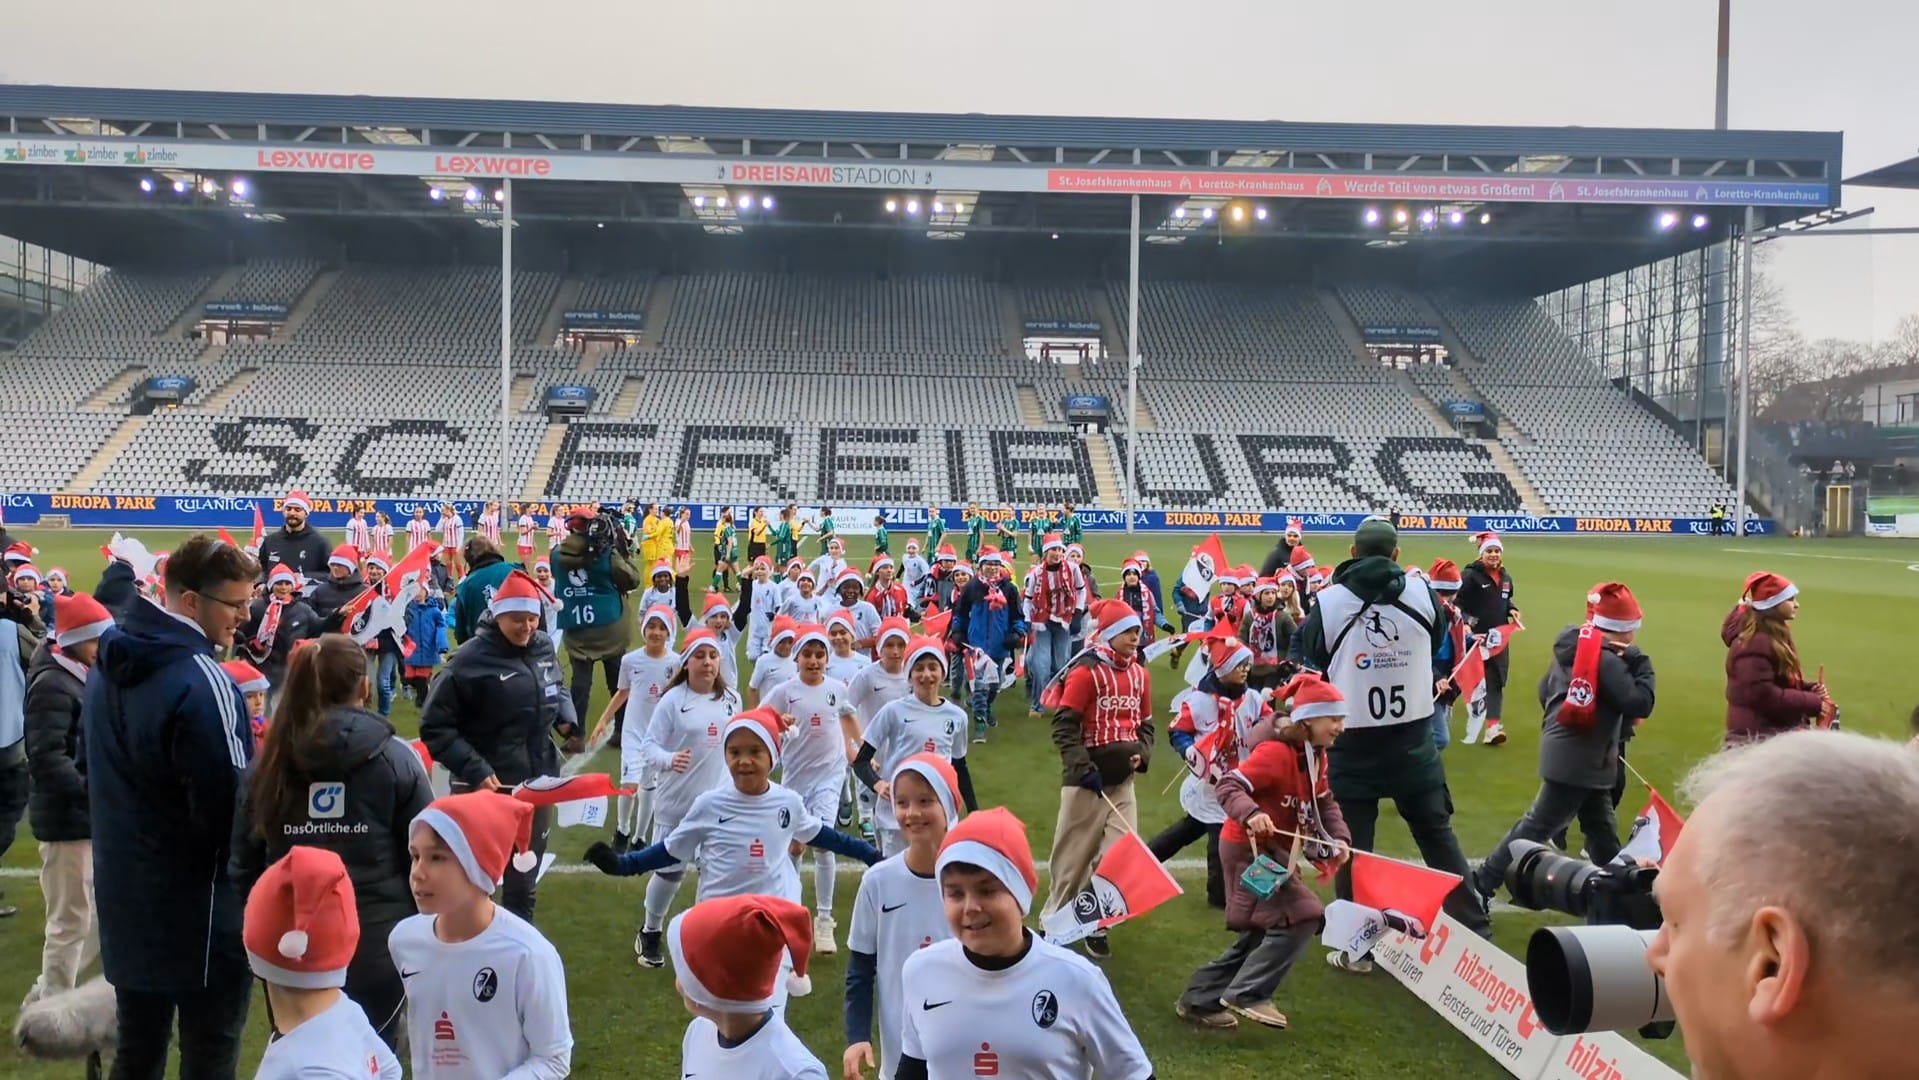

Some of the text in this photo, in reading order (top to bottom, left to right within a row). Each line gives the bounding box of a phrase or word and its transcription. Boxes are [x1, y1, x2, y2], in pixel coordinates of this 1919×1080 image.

[28, 145, 58, 161] zimber
[87, 146, 118, 162] zimber
[147, 148, 178, 163] zimber
[257, 150, 375, 170] Lexware
[434, 156, 551, 175] Lexware
[1059, 176, 1072, 187] St.
[1344, 181, 1384, 193] Werde
[1388, 181, 1410, 193] Teil
[1413, 185, 1436, 195] von
[1440, 184, 1476, 195] etwas
[1577, 186, 1590, 196] St.
[183, 417, 467, 497] SC
[0, 494, 34, 507] TICA
[51, 495, 156, 511] EUROPA PARK
[175, 496, 255, 513] RULANTICA
[273, 500, 333, 514] EOPA
[394, 500, 471, 516] RUANCA
[961, 511, 1058, 523] EROP PAK
[1073, 511, 1148, 526] ULANTA
[1165, 513, 1262, 526] EUROPA PARK
[1286, 514, 1345, 525] RLANTICA
[1398, 516, 1467, 529] OPA PARK
[1485, 517, 1560, 533] RULANTICA
[1576, 519, 1672, 532] EUROPA PARK
[1689, 519, 1764, 535] RULNCA
[571, 604, 595, 625] 16
[1368, 684, 1406, 721] 05
[284, 821, 369, 836] DasÖrtliche.de
[1399, 953, 1424, 985] Türen
[1454, 947, 1526, 1015] hilzinger
[1438, 985, 1523, 1062] Fenster und Türen
